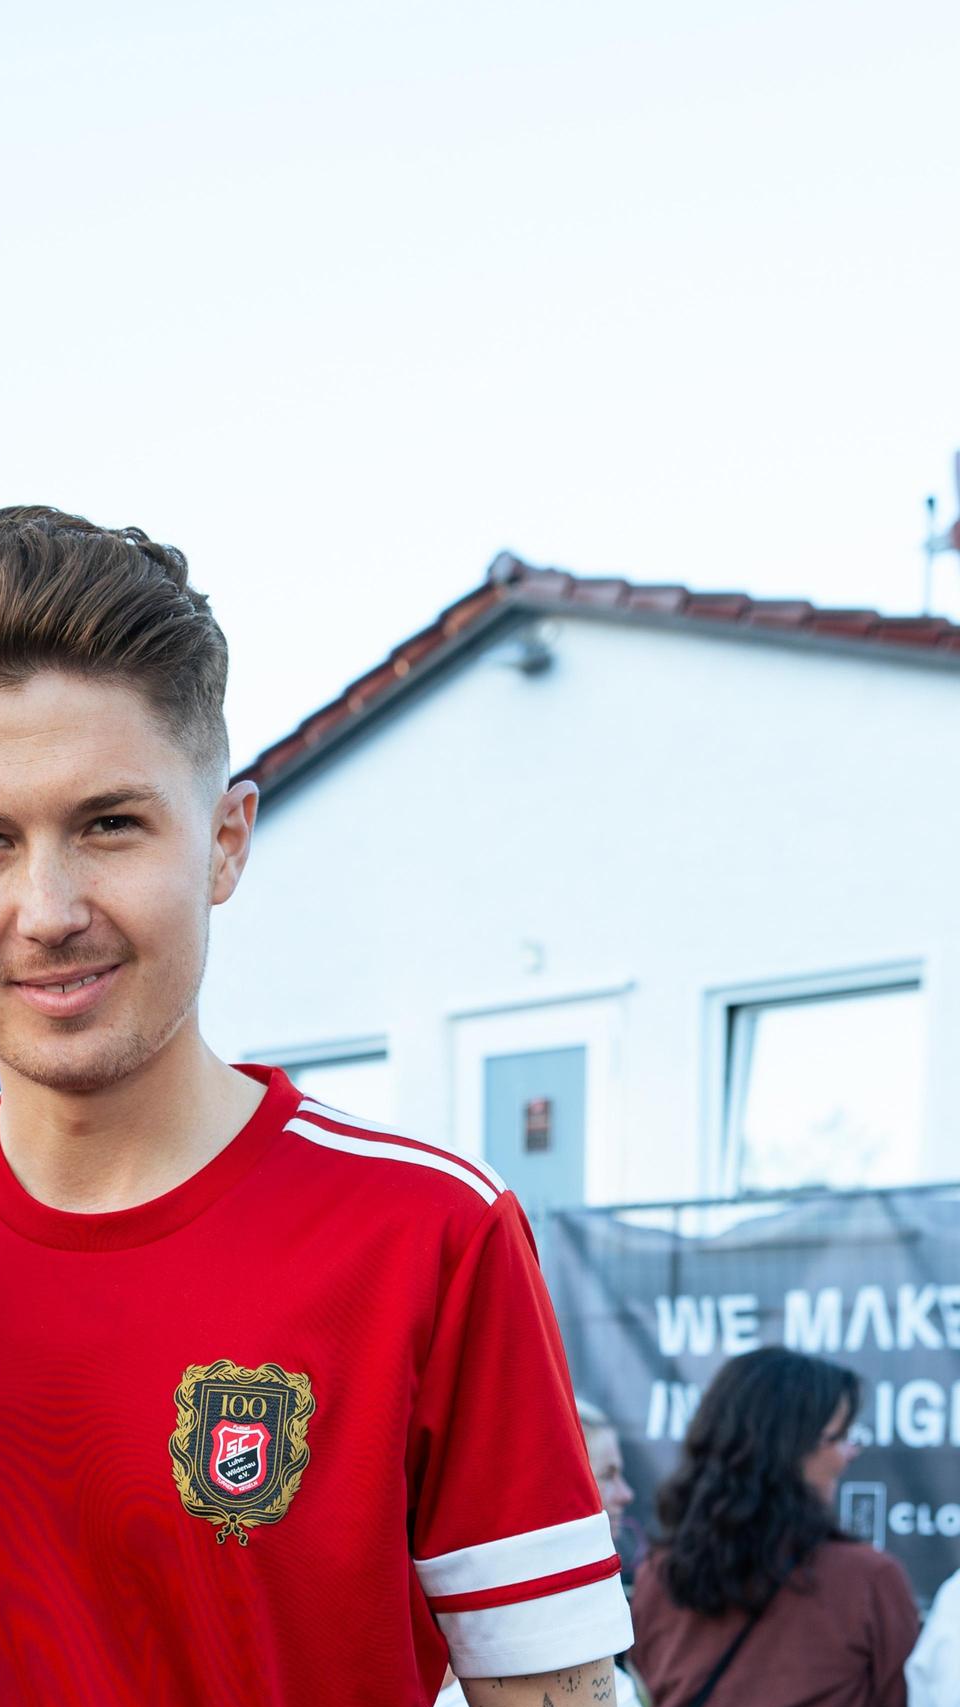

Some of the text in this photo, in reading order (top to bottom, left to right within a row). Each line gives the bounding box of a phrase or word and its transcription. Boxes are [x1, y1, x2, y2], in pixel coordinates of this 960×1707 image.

[655, 1294, 761, 1356] WE
[220, 1394, 267, 1419] 100
[848, 1379, 960, 1448] IG
[226, 1435, 250, 1458] SC
[225, 1461, 257, 1477] Wildenau
[227, 1457, 247, 1468] Luhe-
